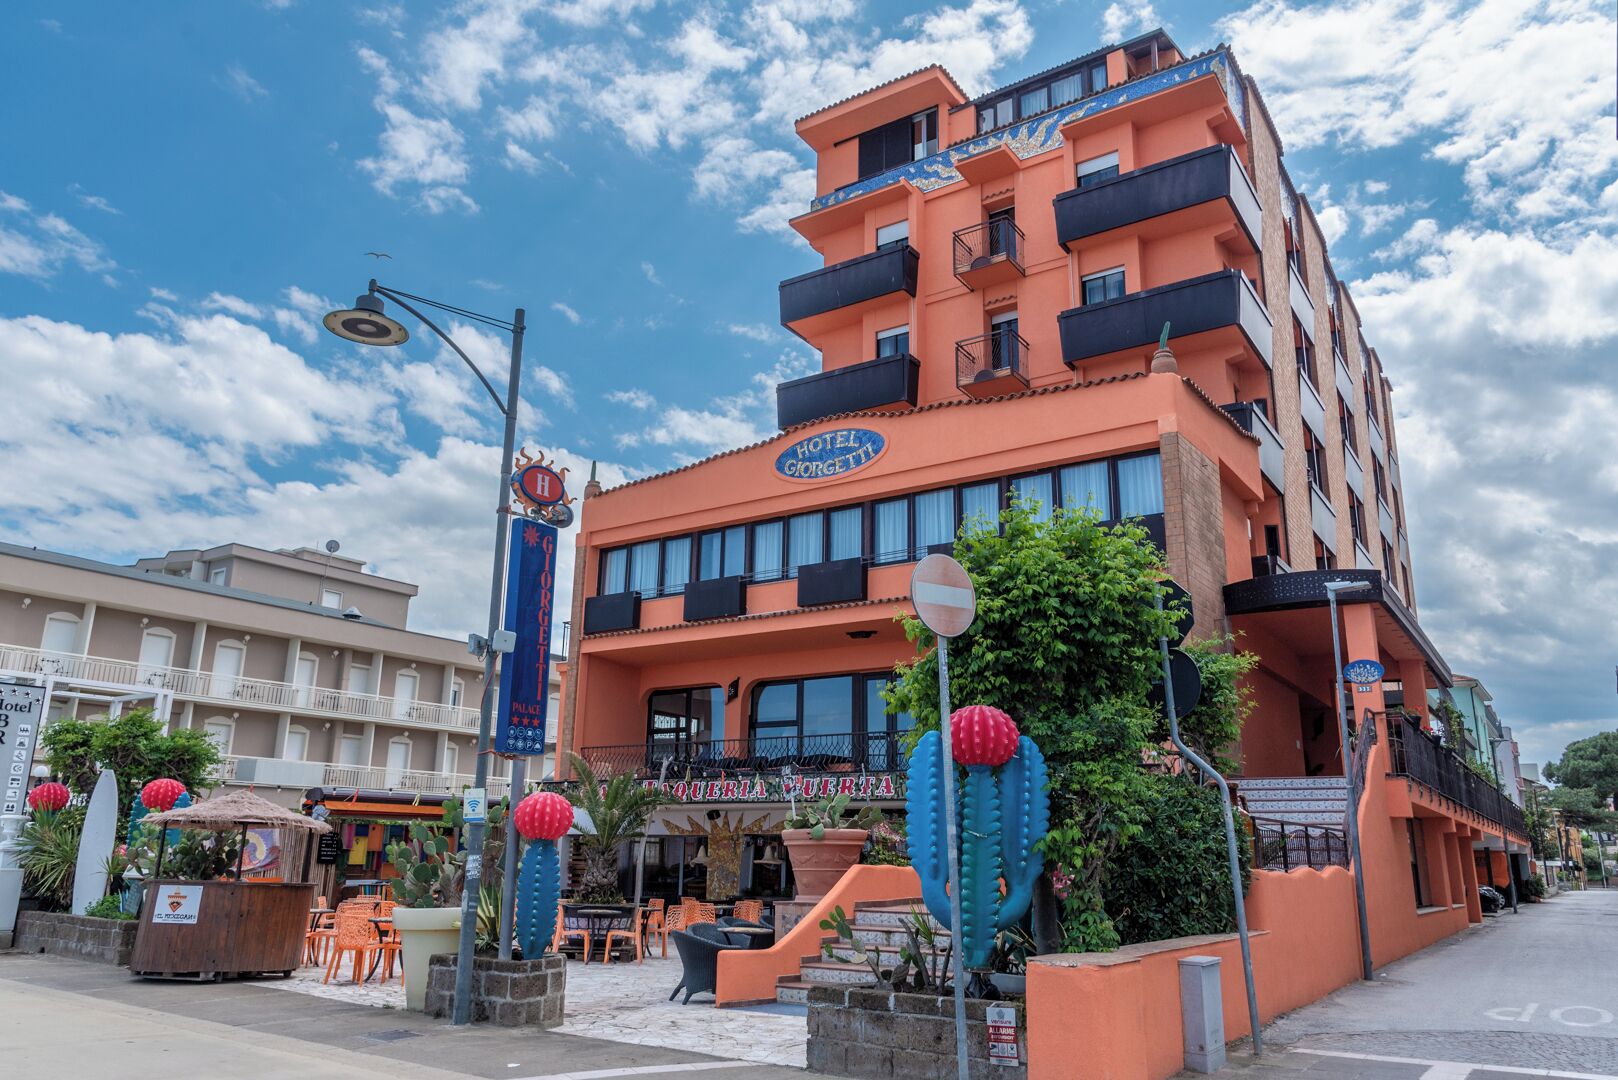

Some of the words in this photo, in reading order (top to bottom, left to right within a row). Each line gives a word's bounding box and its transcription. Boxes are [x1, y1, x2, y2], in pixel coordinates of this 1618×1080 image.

[796, 431, 859, 459] HOTEL
[784, 441, 875, 477] GIORGETTI
[536, 472, 550, 497] H
[537, 535, 553, 701] GIORGETTI
[512, 701, 541, 715] PALACE
[989, 1027, 1015, 1035] ALLARME
